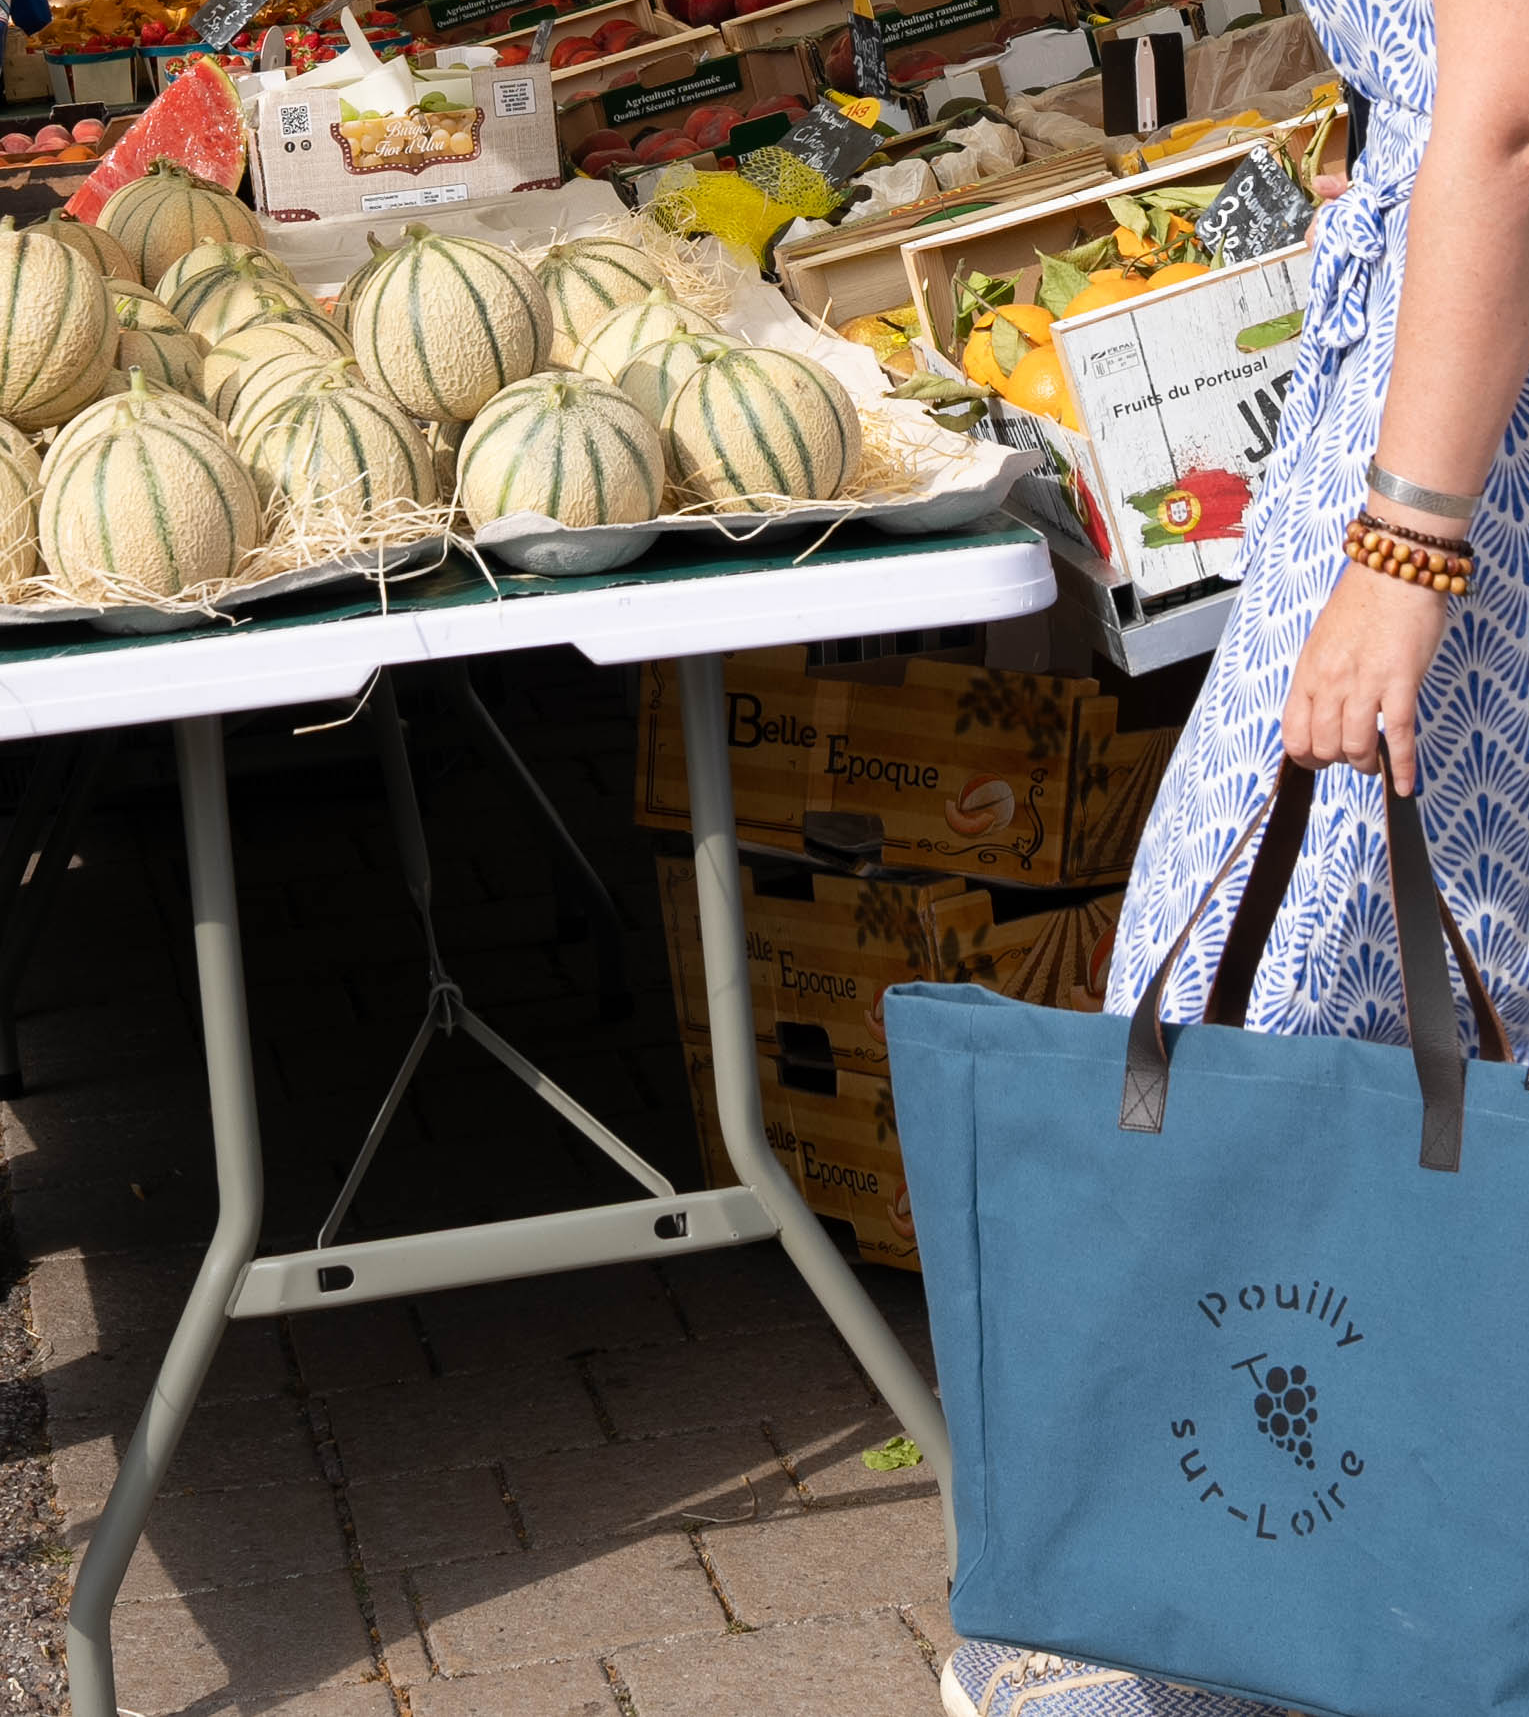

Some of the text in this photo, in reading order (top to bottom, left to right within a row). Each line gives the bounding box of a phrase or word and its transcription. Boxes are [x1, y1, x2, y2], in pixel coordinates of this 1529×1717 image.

[436, 14, 459, 29] Qualité
[462, 6, 487, 22] Sécurité
[884, 10, 935, 33] Agriculture
[905, 22, 935, 38] Sécurité
[938, 3, 995, 28] Environnement
[613, 109, 640, 123] Qualité
[645, 98, 676, 114] Sécurité
[680, 81, 736, 104] Environnement
[625, 74, 721, 109] Agriculture raisonnée
[1113, 355, 1269, 419] Fruits du Portugal
[725, 692, 940, 791] Belle Epoque
[778, 949, 857, 1002] Epoque
[802, 1140, 880, 1195] Epoque
[1198, 1280, 1364, 1348] Pouilly
